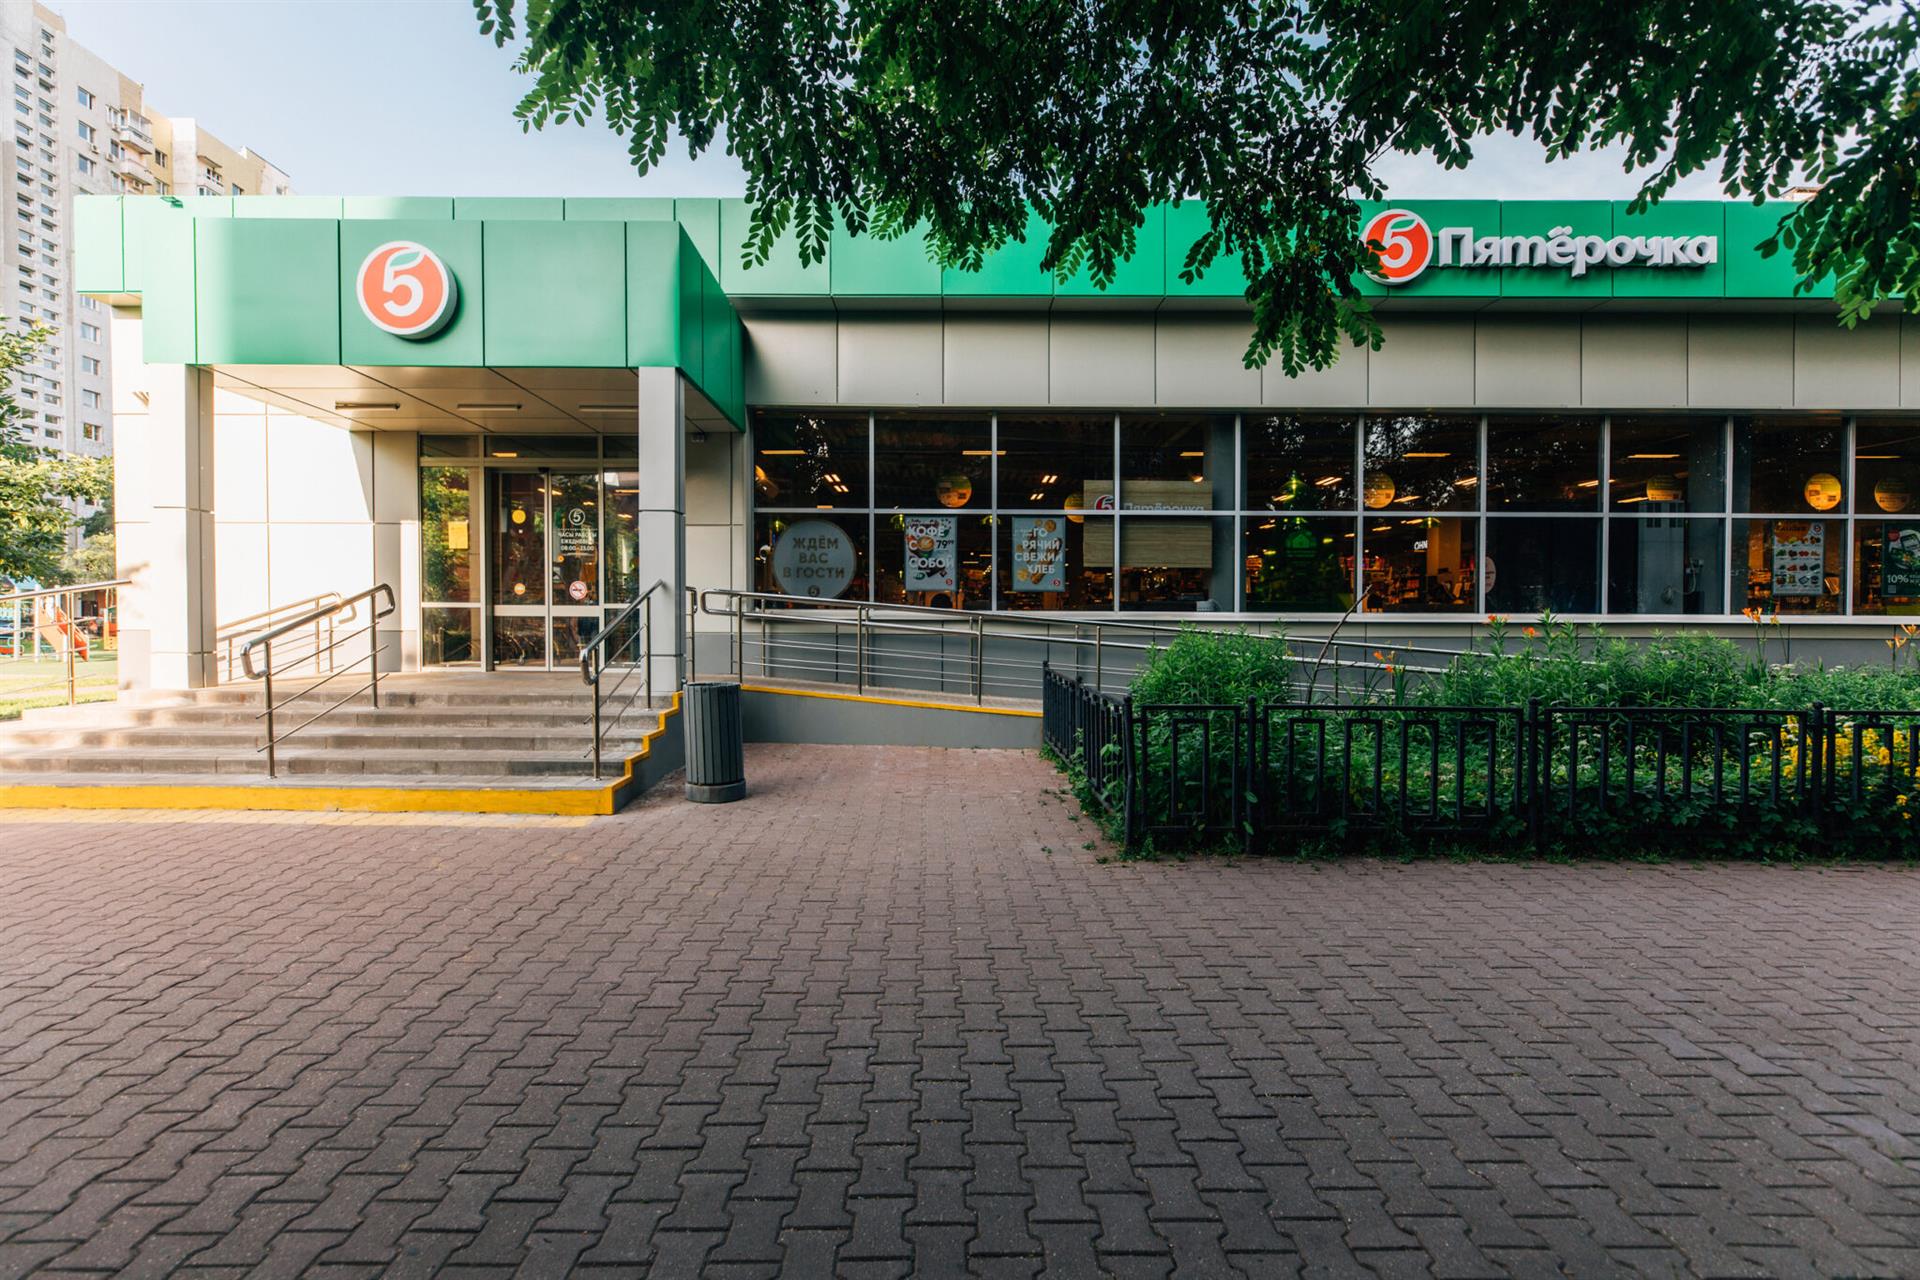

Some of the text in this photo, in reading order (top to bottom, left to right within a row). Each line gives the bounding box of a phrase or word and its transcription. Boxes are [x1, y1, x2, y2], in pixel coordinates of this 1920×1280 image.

[1439, 226, 1718, 278] Пятёрочка
[382, 247, 425, 317] 5
[909, 526, 945, 537] КОФЕ
[793, 535, 838, 550] ЖДЁМ
[1023, 538, 1060, 550] РЯЧИЙ
[799, 553, 828, 563] ВАС
[909, 555, 953, 568] СОБОЙ
[783, 567, 845, 578] В ГОСТИ
[1027, 564, 1055, 574] ХЛЕБ
[1887, 574, 1909, 584] 10%
